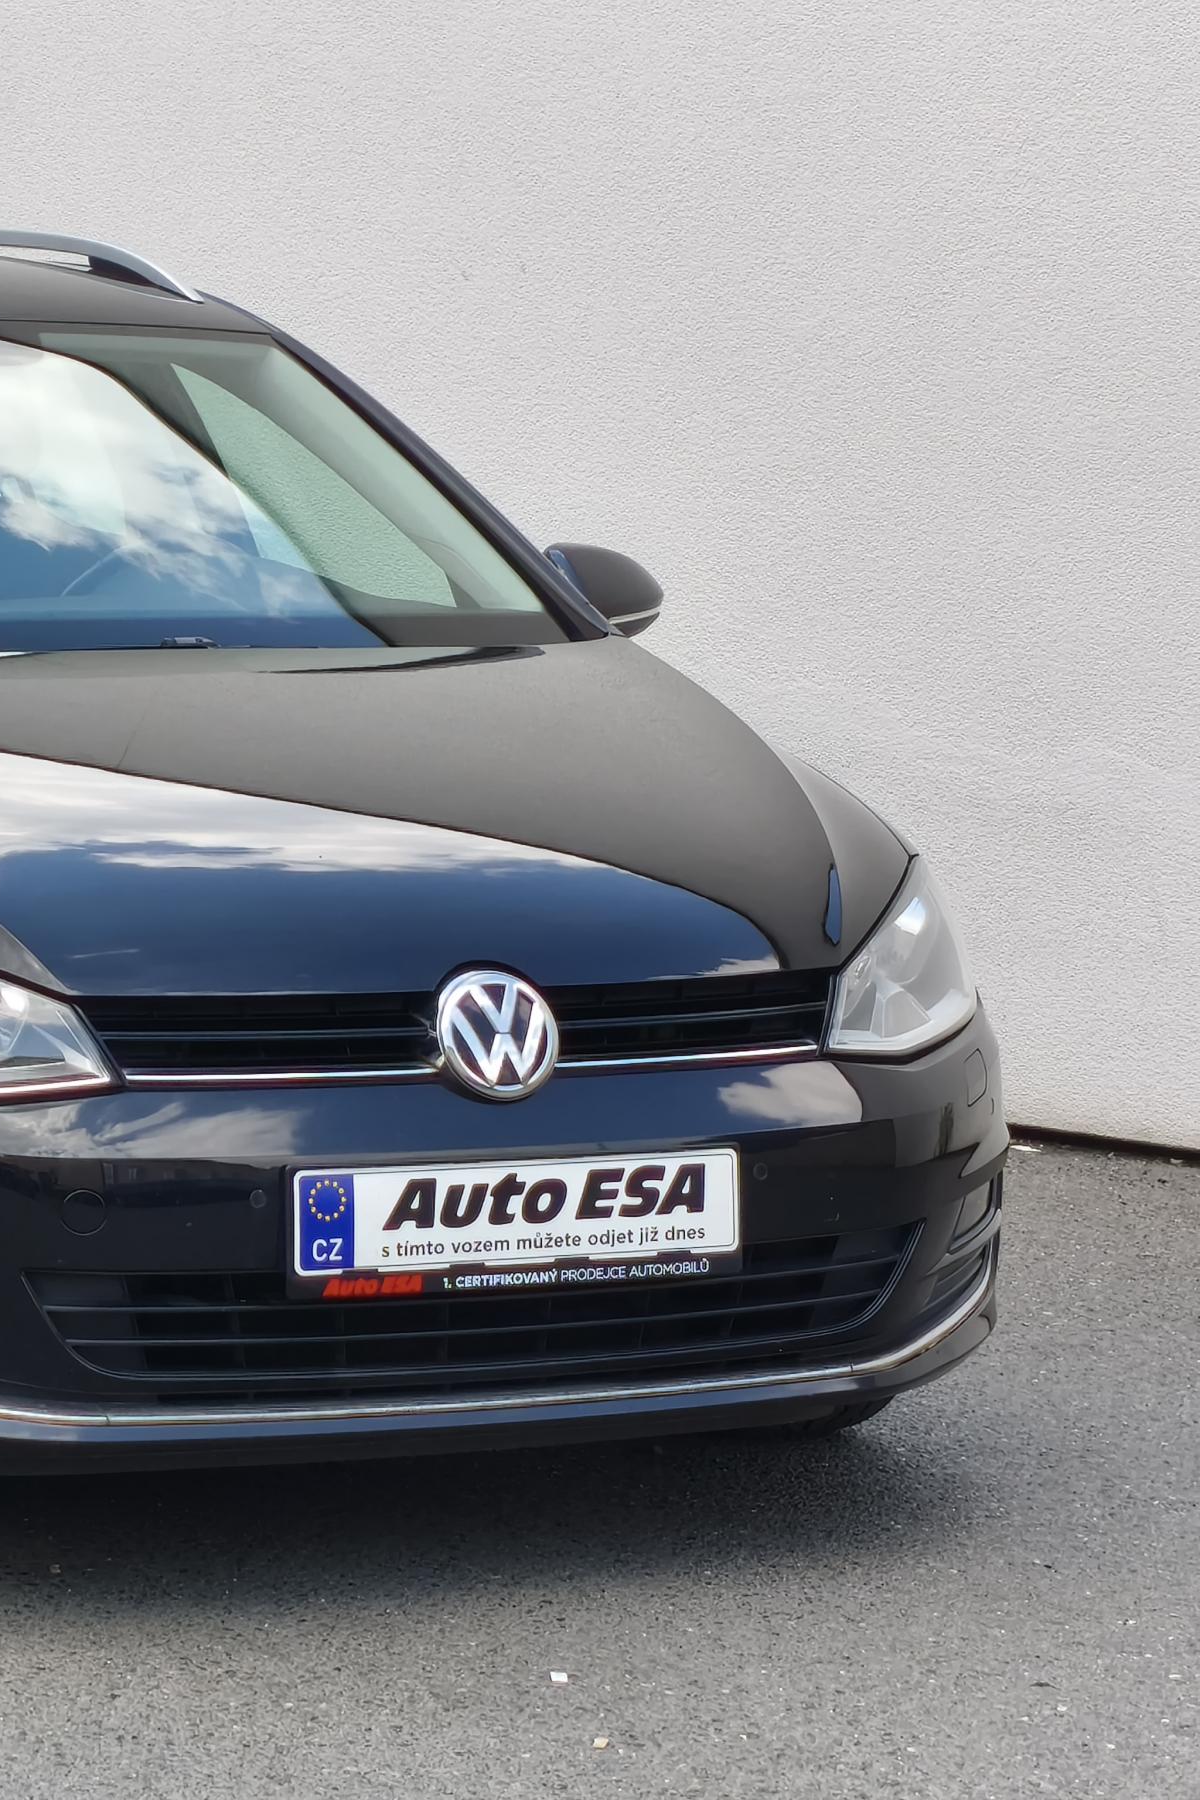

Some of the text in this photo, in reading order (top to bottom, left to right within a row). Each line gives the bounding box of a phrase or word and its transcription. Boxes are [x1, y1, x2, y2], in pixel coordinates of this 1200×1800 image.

[448, 979, 550, 1090] VW
[382, 1162, 706, 1231] Auto ESA
[312, 1238, 343, 1262] CZ
[381, 1225, 706, 1258] s tímto vozem můžete odjet již dnes
[322, 1278, 380, 1298] Auto
[442, 1257, 710, 1289] 1. CERTIFIKOVANÝ PRODEJCE AUTOMOBILŮ
